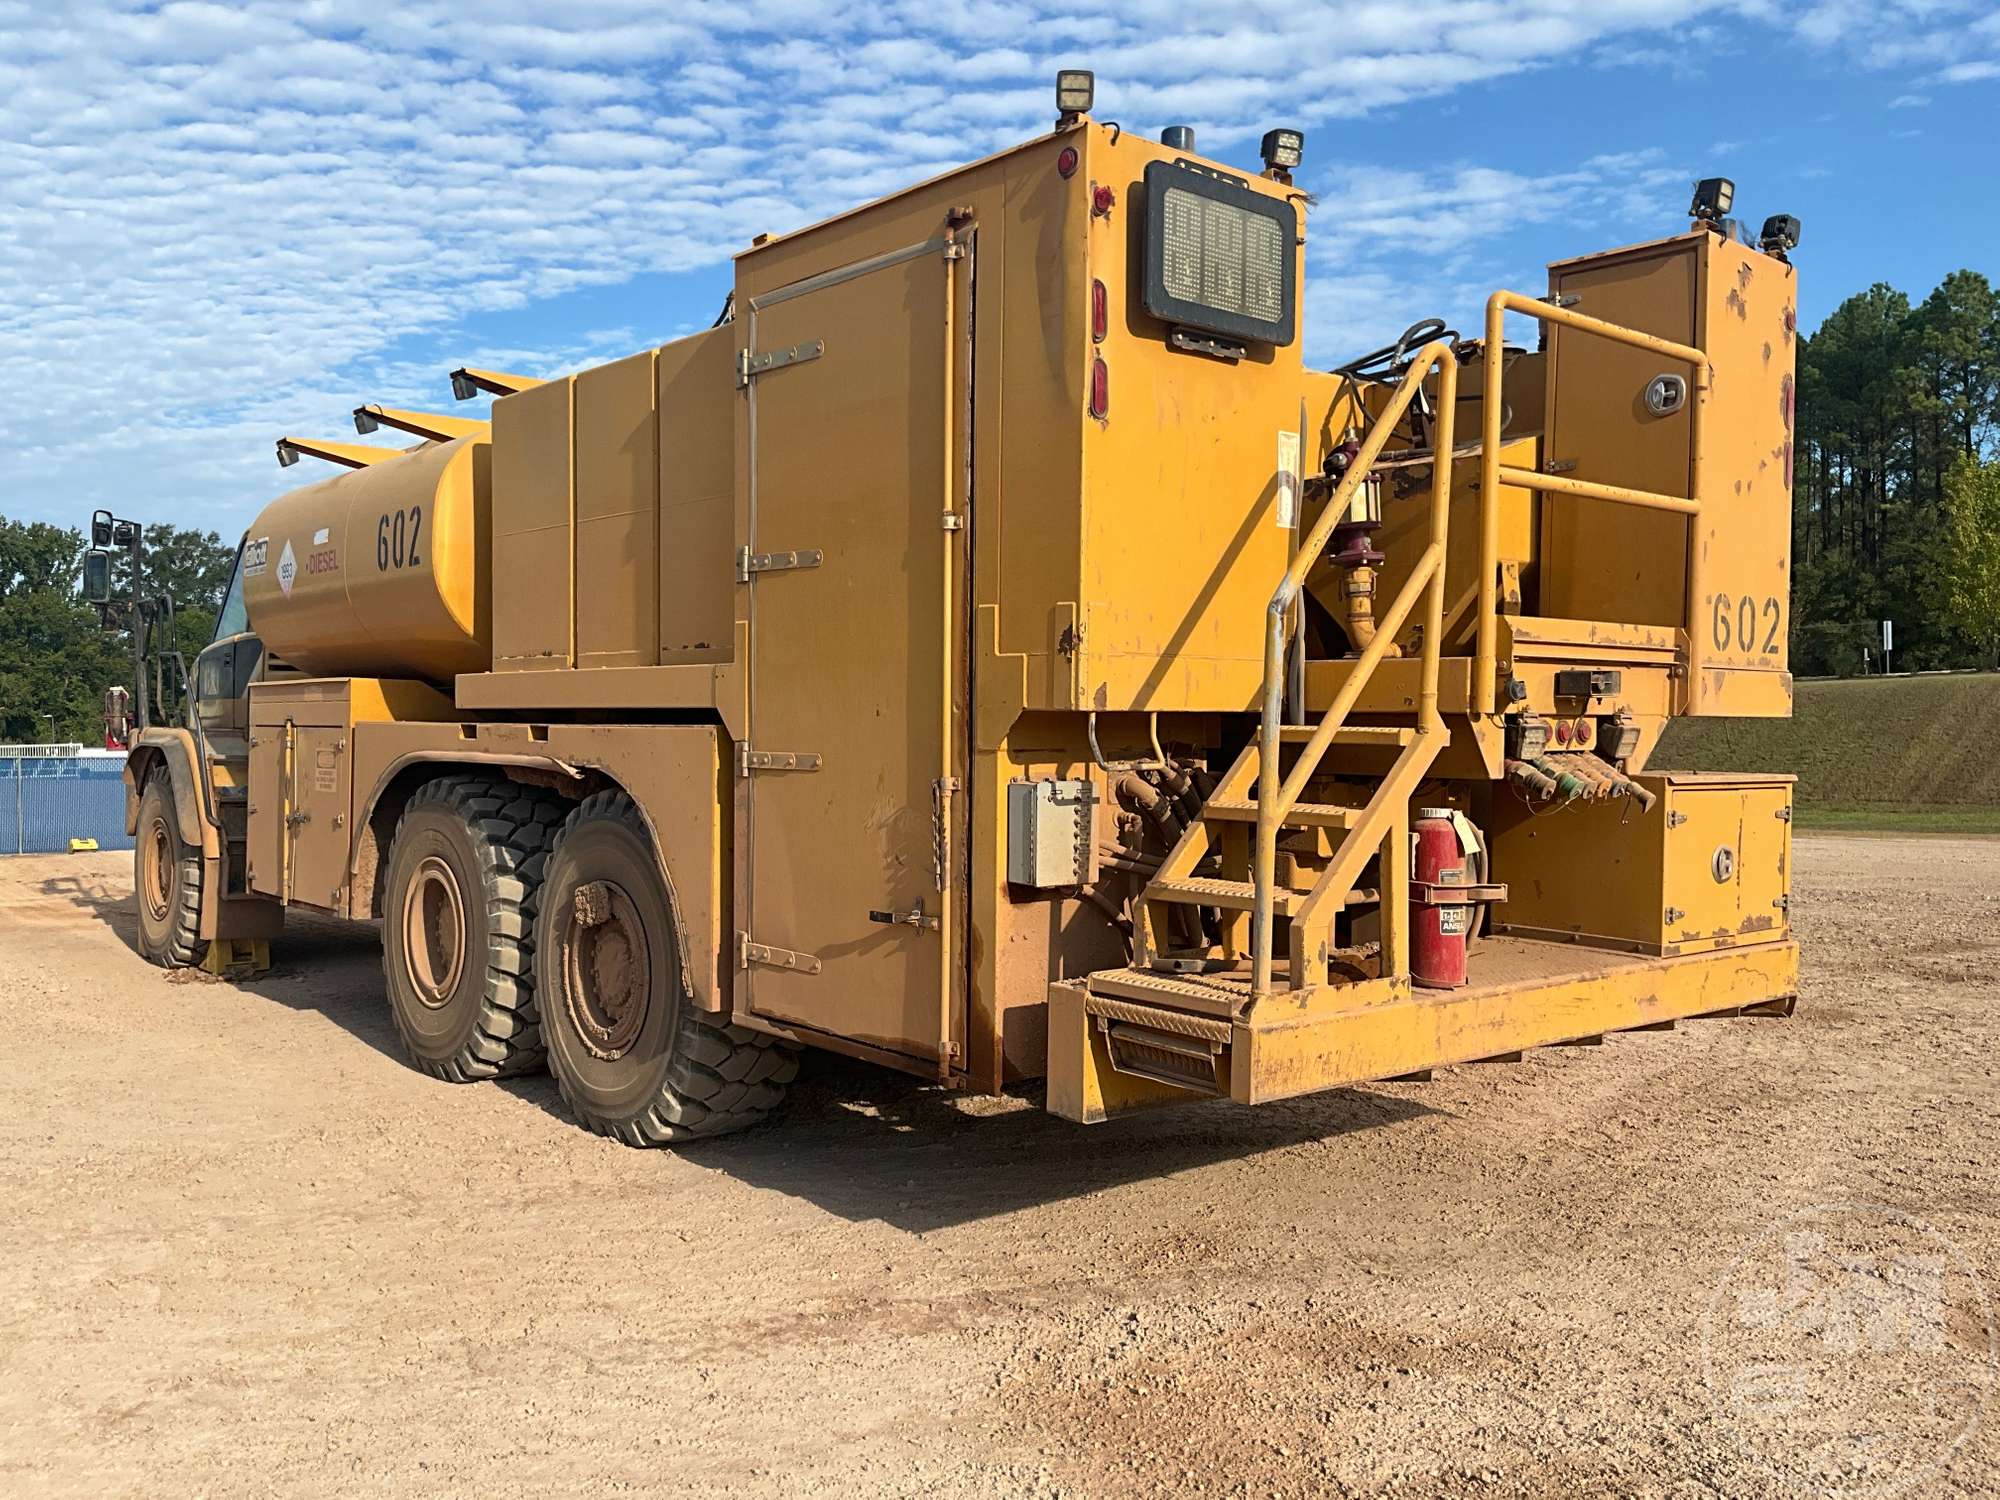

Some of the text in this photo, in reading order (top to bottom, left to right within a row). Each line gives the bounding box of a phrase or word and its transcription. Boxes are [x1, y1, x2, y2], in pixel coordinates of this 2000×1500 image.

[309, 549, 339, 575] DIESEL
[377, 505, 422, 572] 602
[1713, 592, 1780, 654] 602
